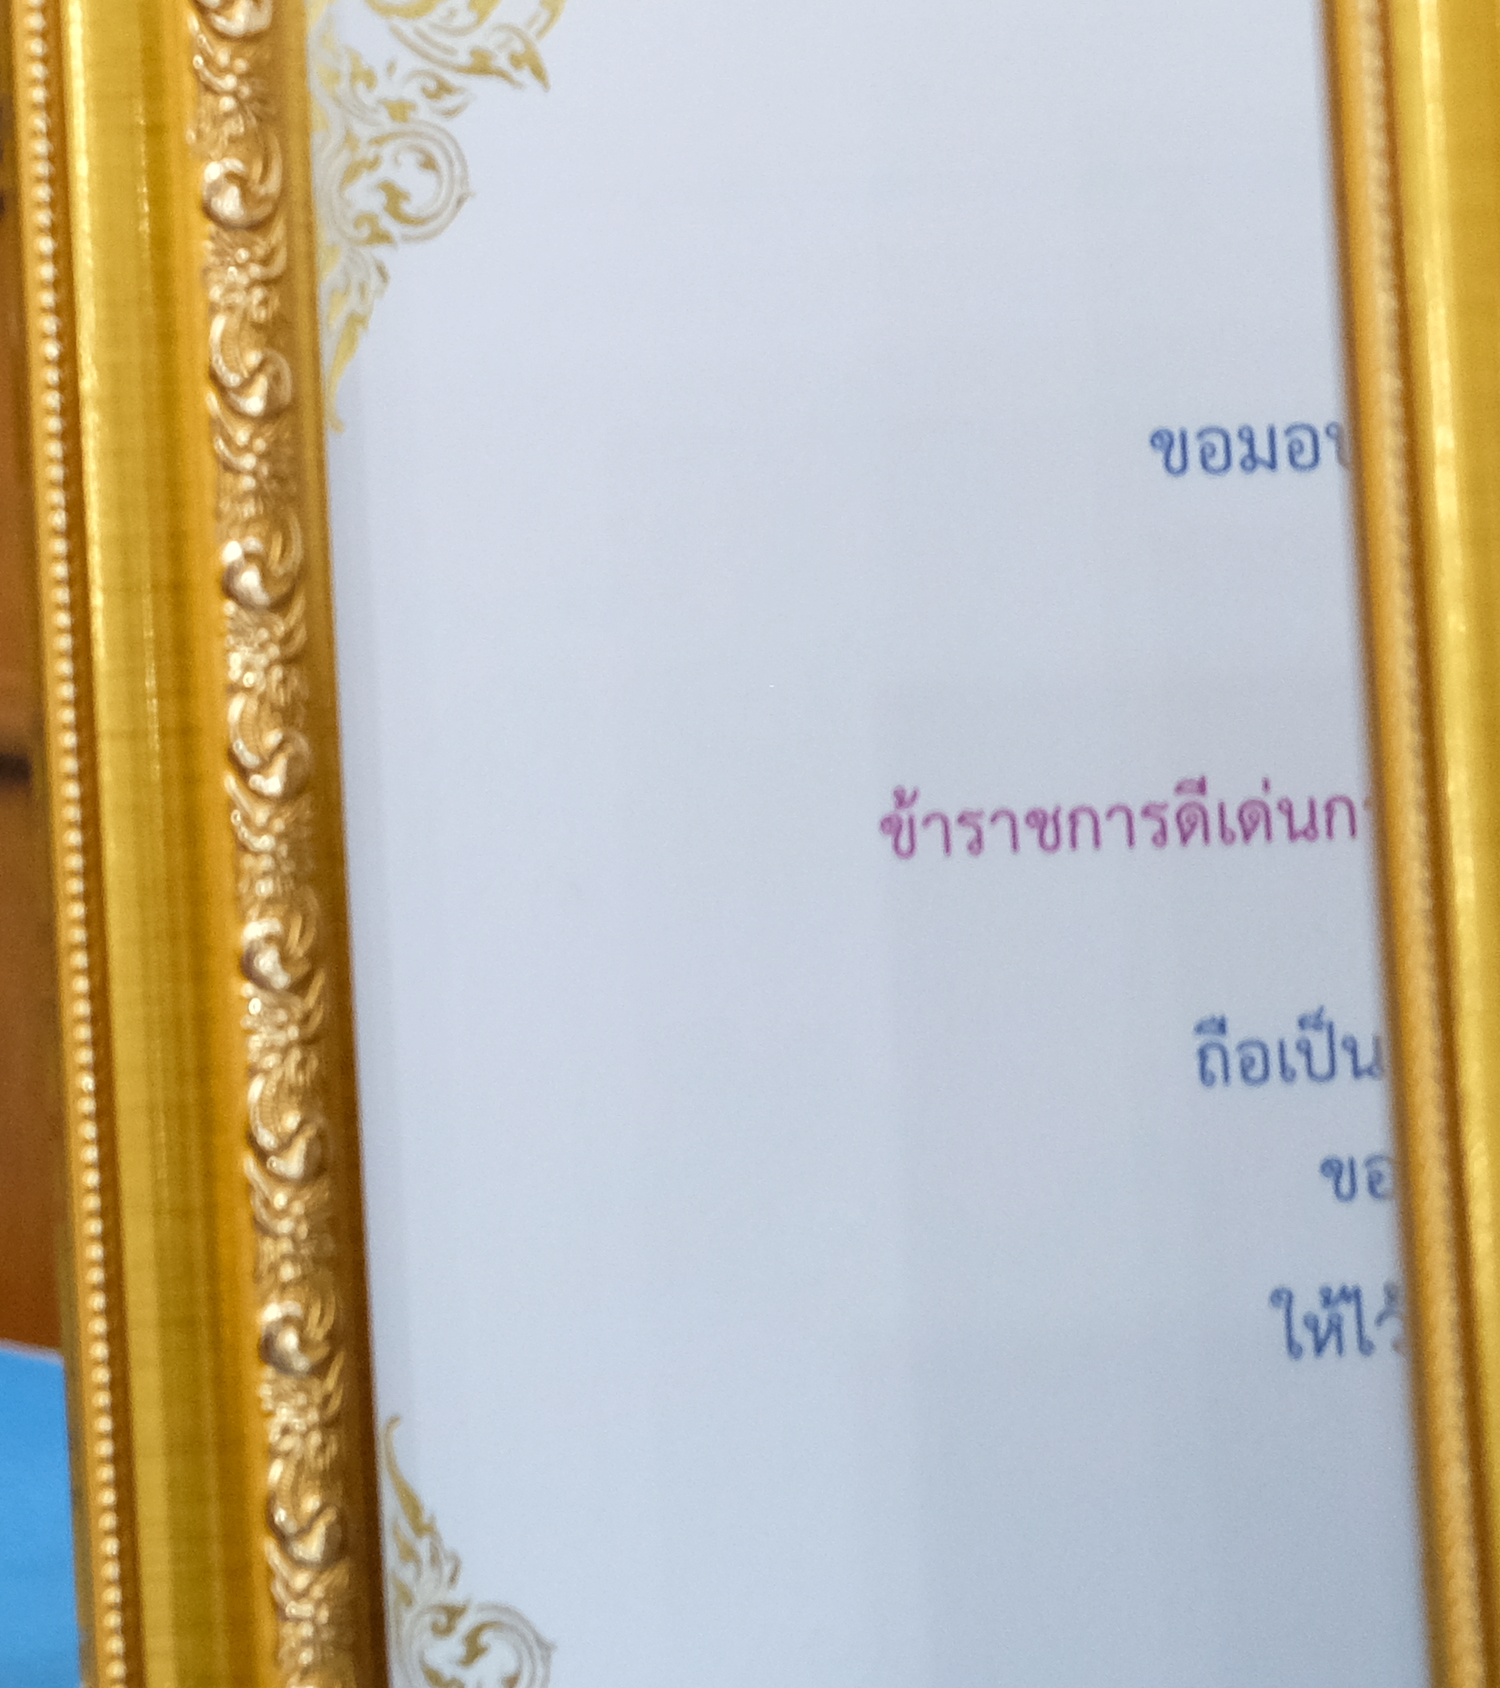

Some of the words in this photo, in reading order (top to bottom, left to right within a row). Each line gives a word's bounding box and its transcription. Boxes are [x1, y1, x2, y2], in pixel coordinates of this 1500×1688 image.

[878, 773, 1375, 860] ข้าราชการดีเด่นก
[1192, 1005, 1386, 1089] ถือเป็น
